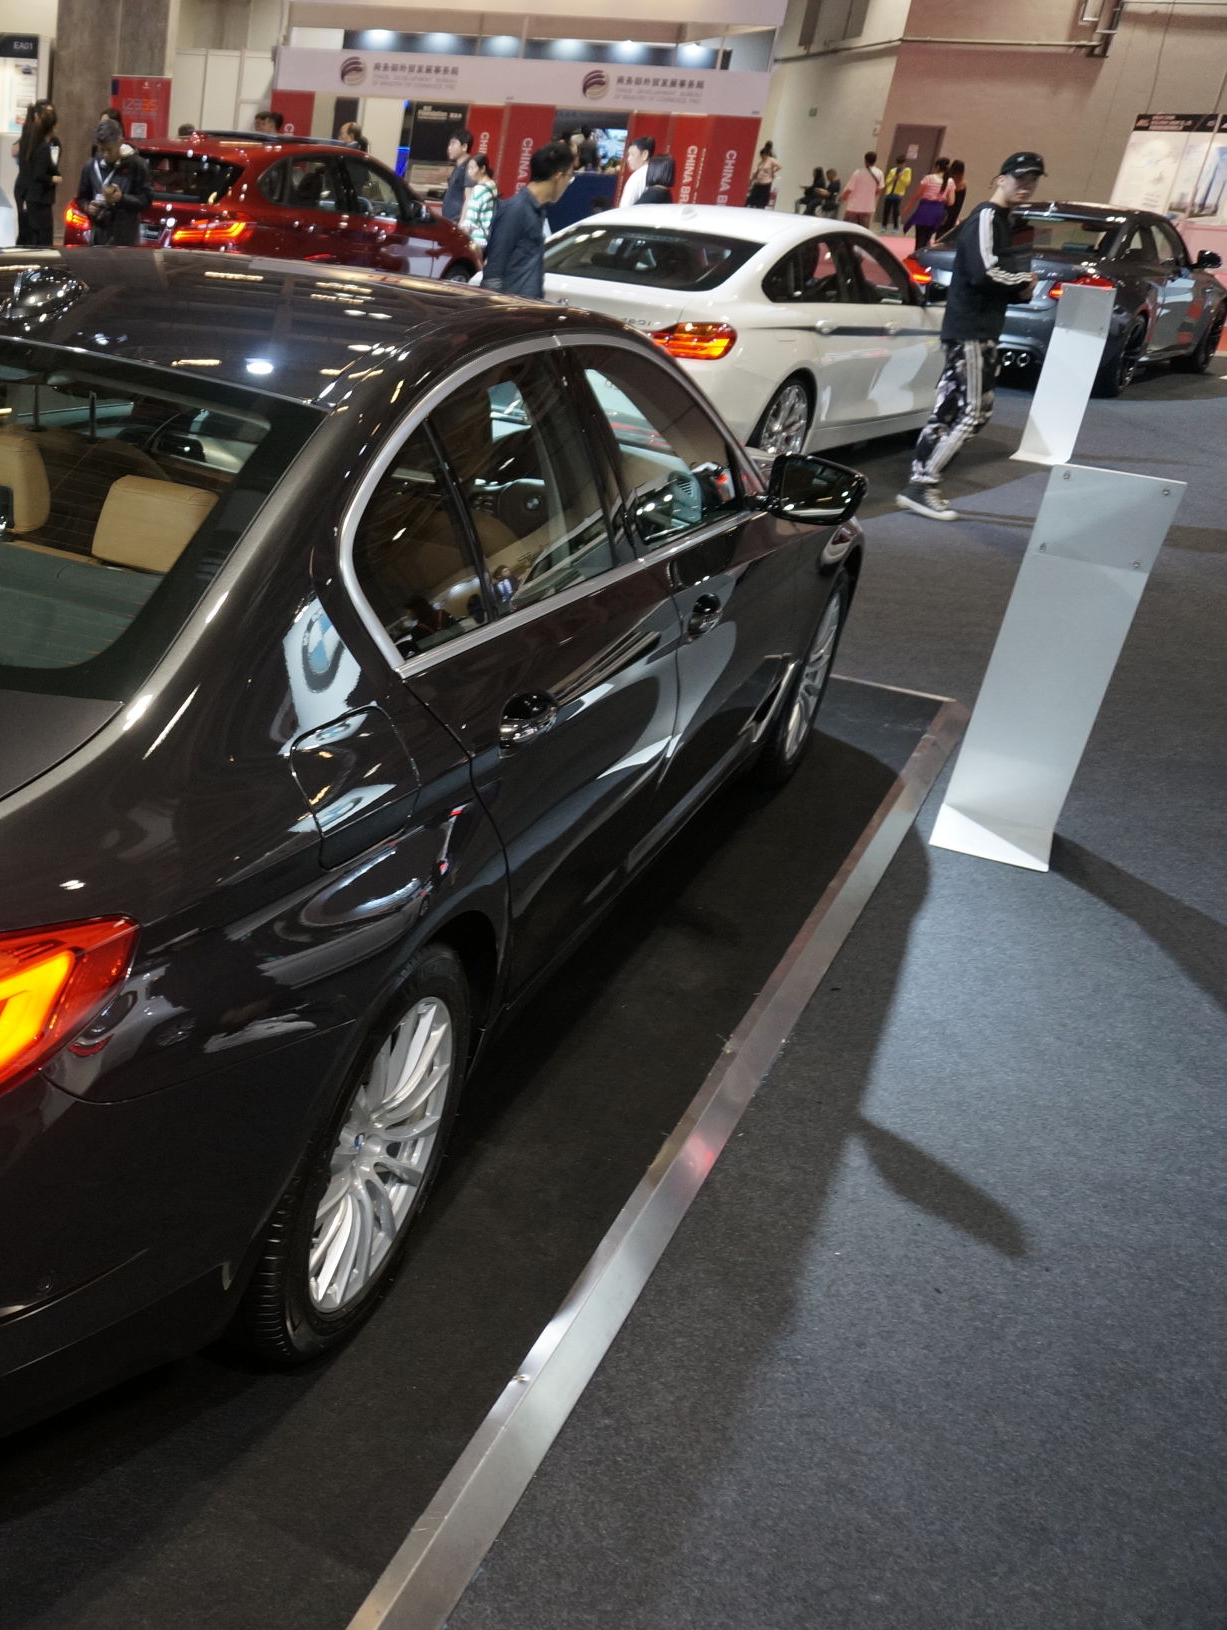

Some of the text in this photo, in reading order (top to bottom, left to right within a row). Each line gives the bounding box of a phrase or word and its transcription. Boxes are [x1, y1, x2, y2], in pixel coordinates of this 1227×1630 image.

[13, 41, 32, 50] EA01
[478, 131, 490, 154] CHI
[518, 137, 534, 179] CHINA
[682, 145, 698, 184] CHINA
[719, 149, 737, 191] CHINA
